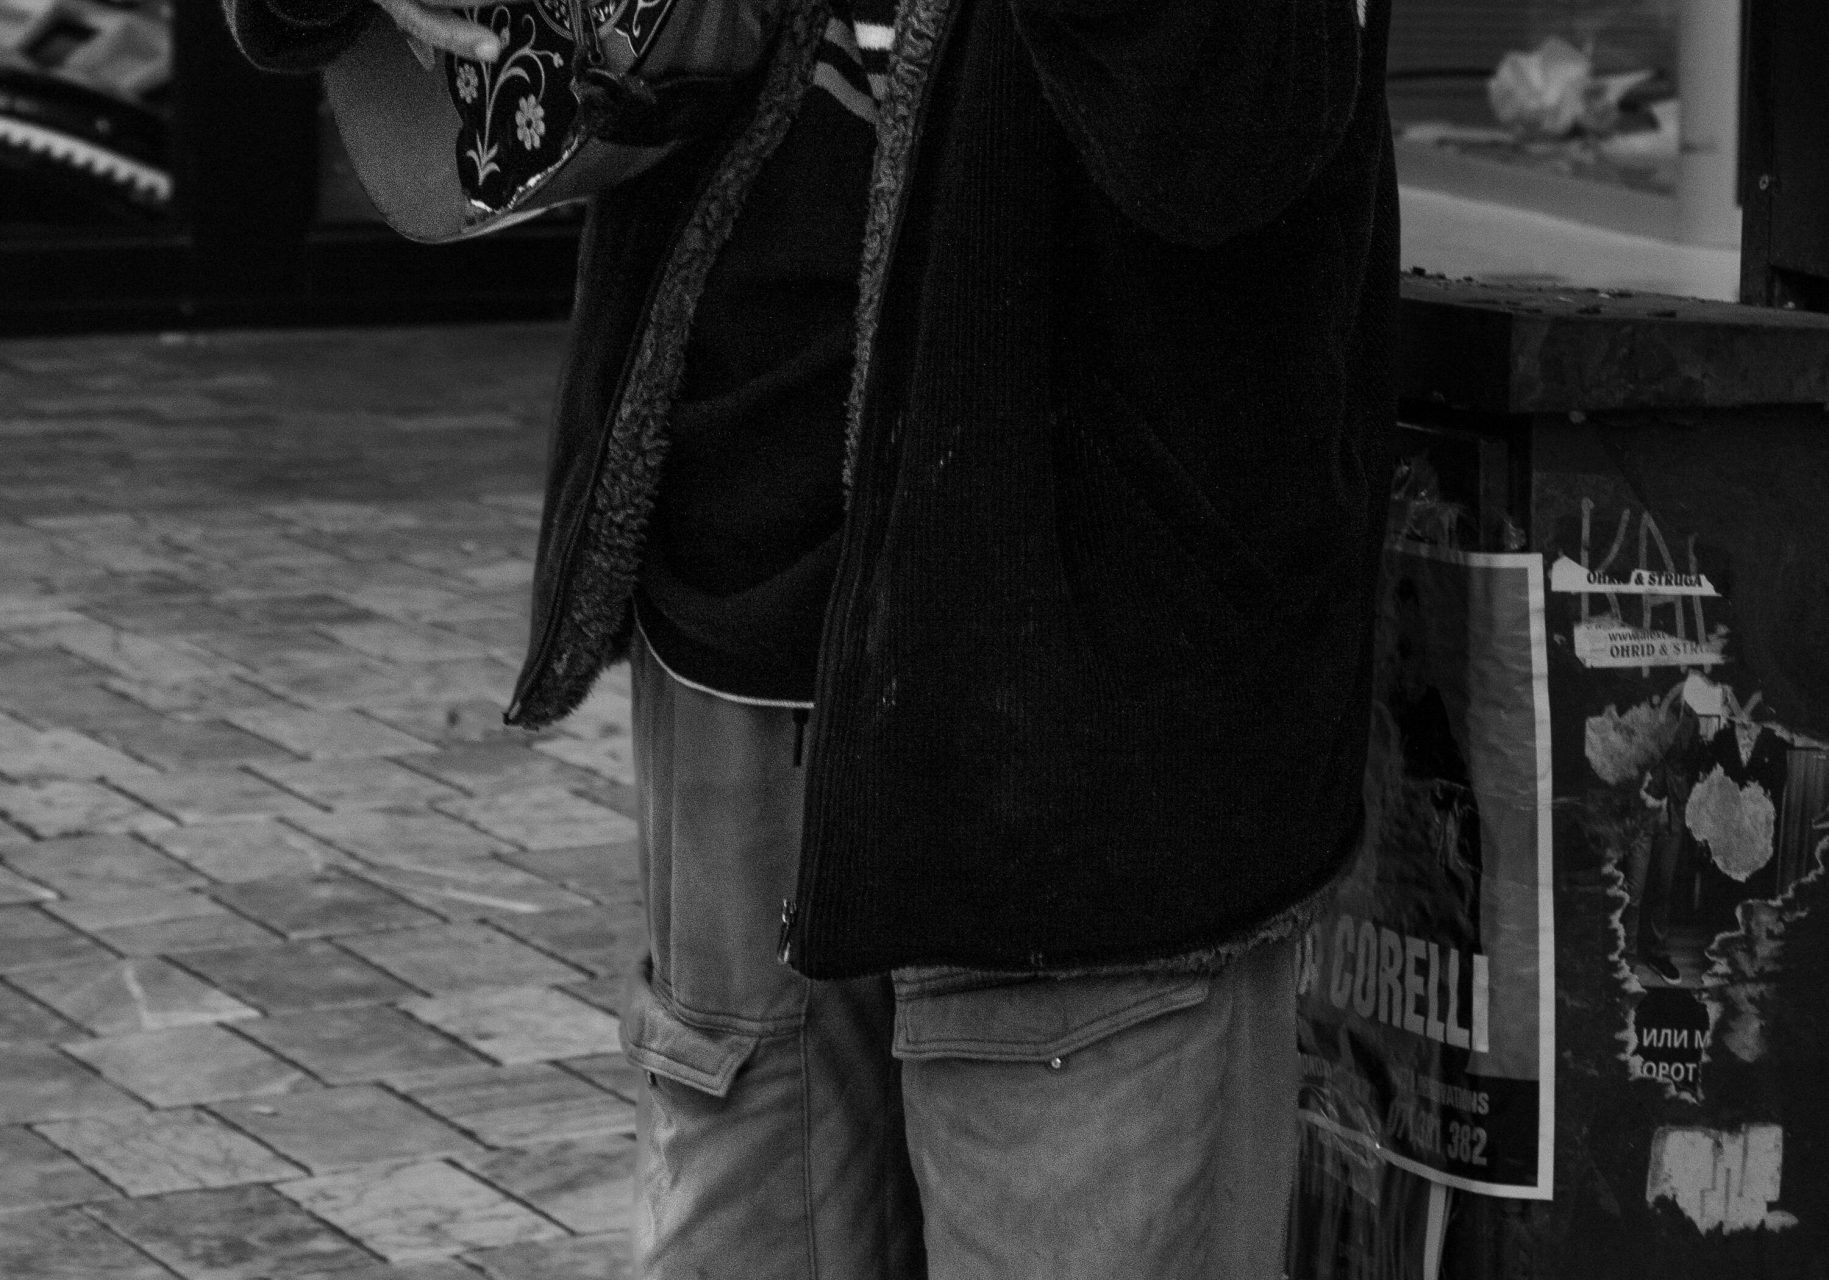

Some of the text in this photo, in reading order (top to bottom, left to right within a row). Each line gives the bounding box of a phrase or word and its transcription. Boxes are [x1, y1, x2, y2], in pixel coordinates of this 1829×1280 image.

[1634, 573, 1645, 585] &
[1610, 644, 1655, 658] OHRID
[1659, 644, 1669, 655] &
[1329, 914, 1490, 1052] CORELLI
[1642, 1027, 1688, 1049] ИЛИ
[1447, 1120, 1488, 1165] 382
